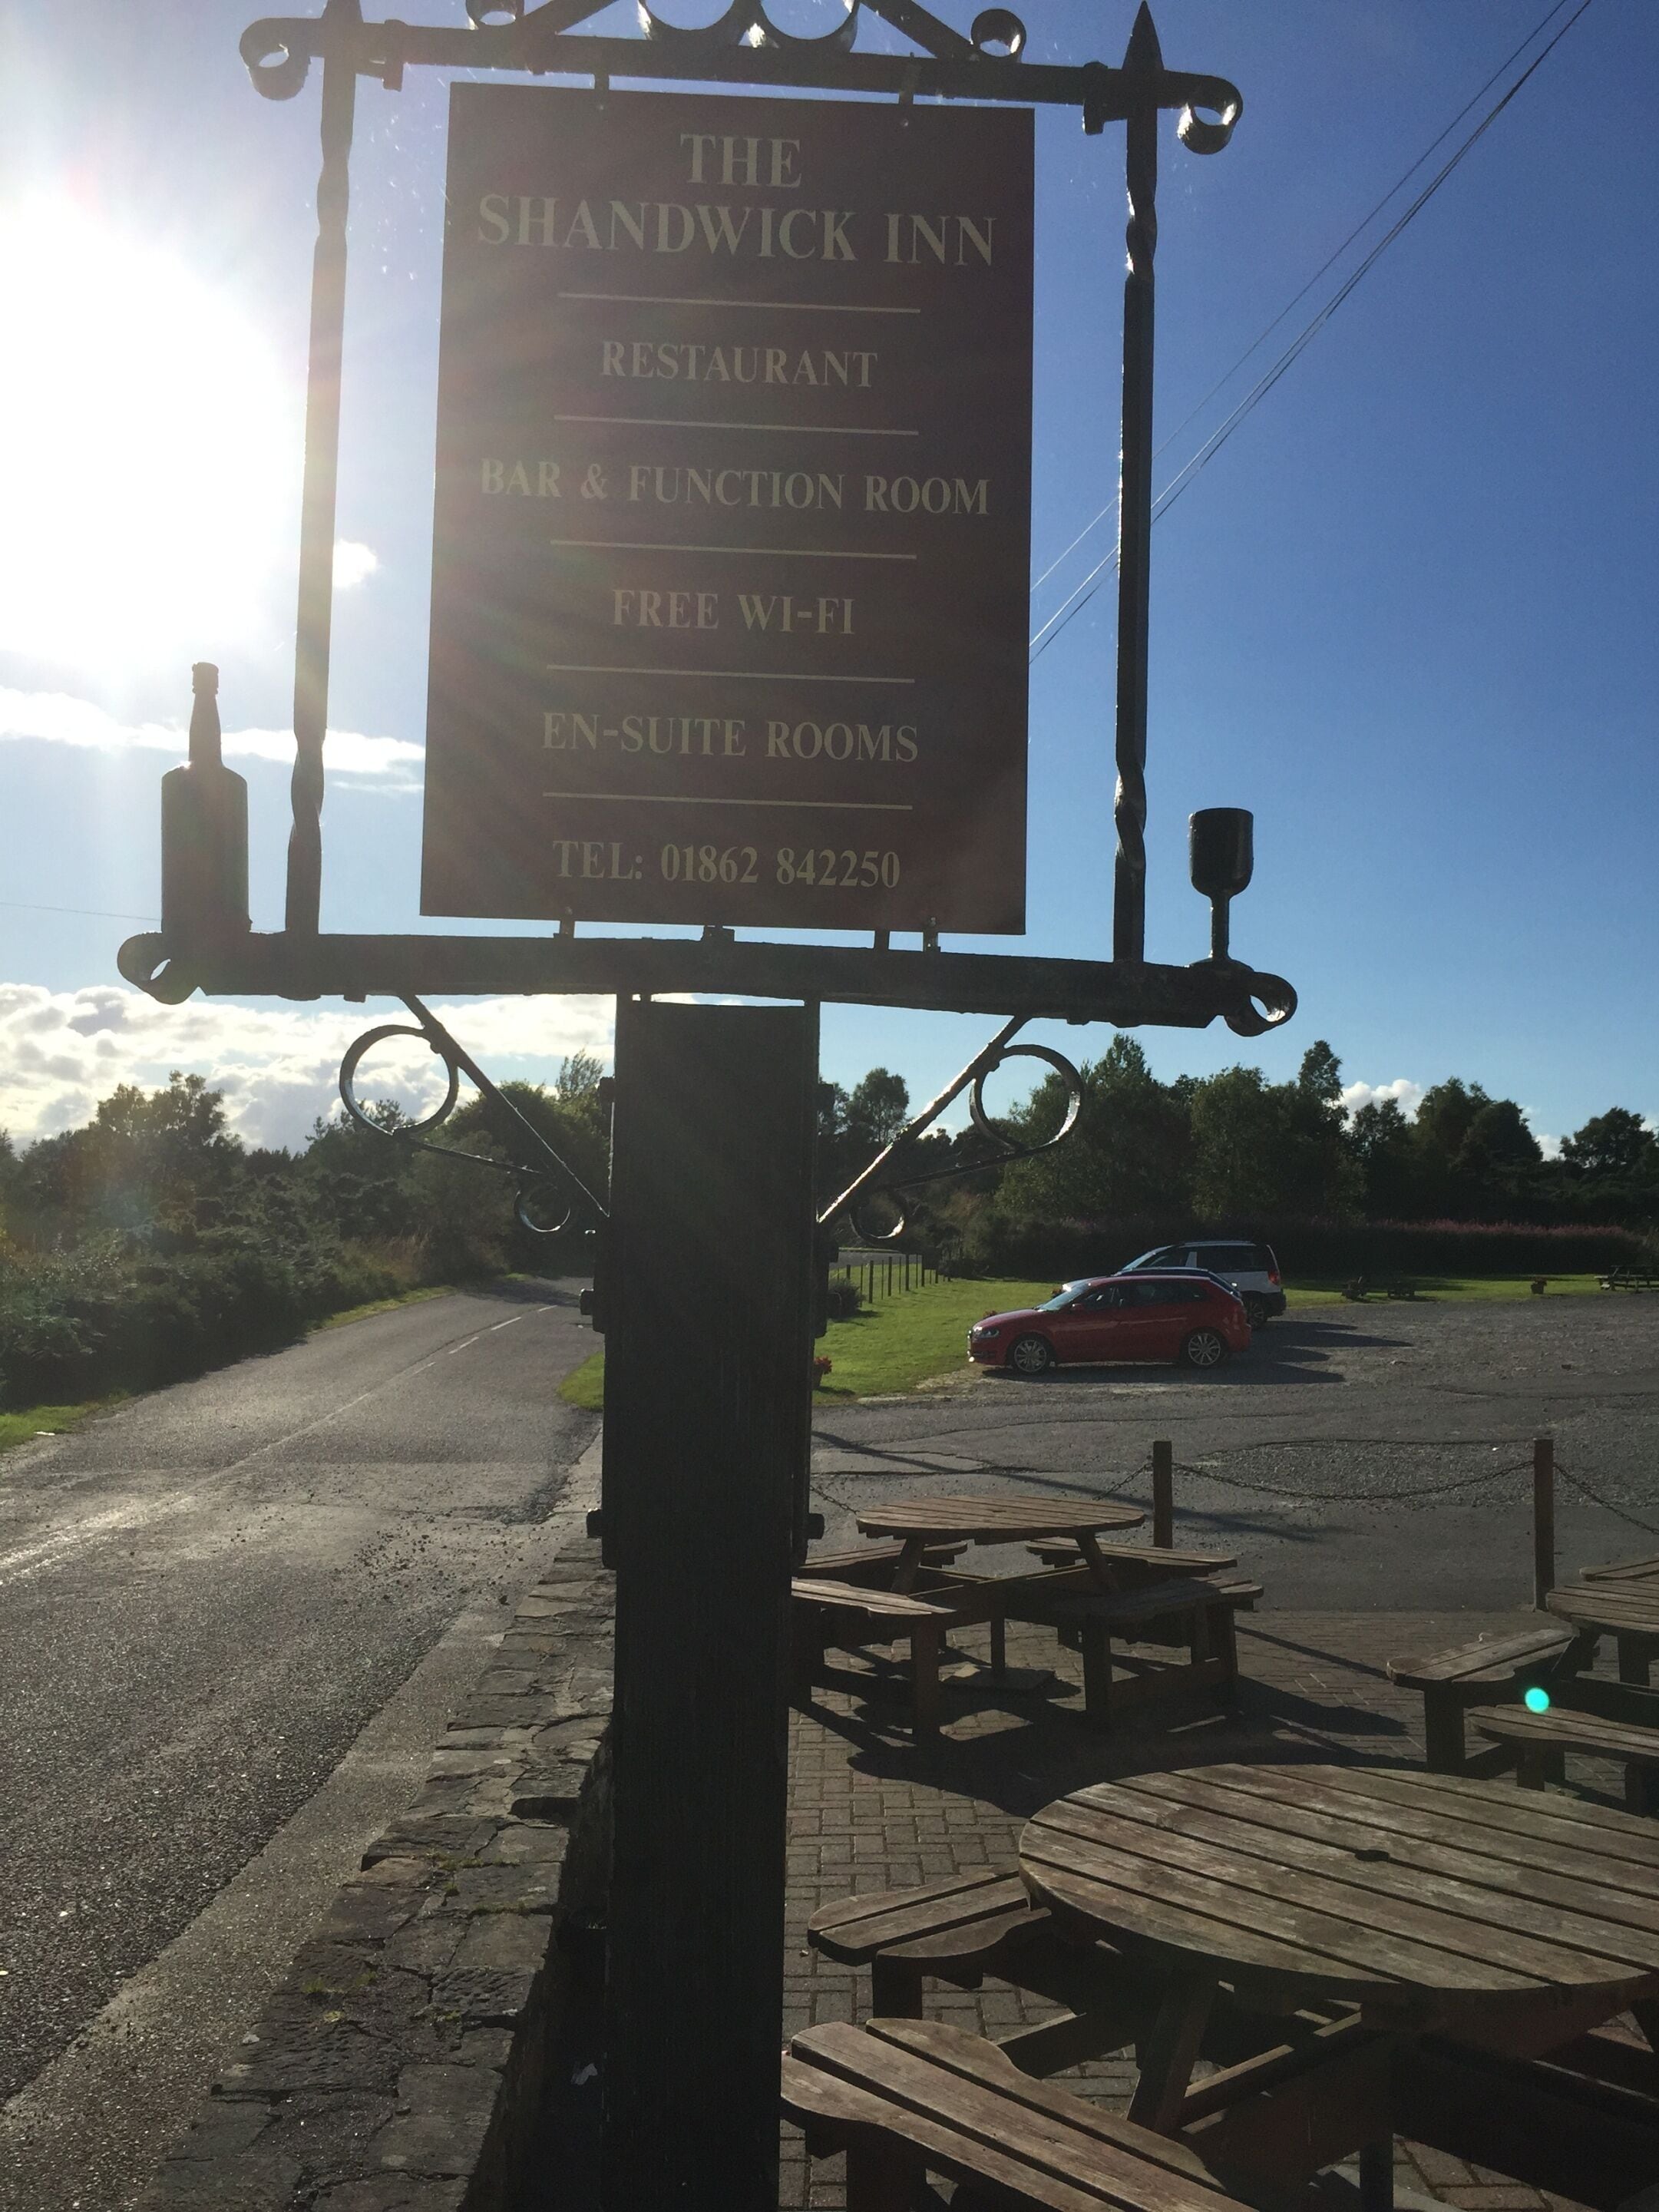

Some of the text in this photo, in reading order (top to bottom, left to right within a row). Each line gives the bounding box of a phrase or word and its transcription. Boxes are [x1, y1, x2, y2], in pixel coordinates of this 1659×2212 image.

[680, 132, 801, 187] THE
[478, 193, 998, 267] SHANDWICK INN
[603, 340, 878, 389] RESTAURANT
[481, 458, 990, 515] BAR & FUNCTION ROOM
[612, 589, 854, 634] FREE WI-FI
[542, 713, 918, 762] EN-SUITE ROOMS
[553, 839, 901, 888] TEL: 01862 842250
